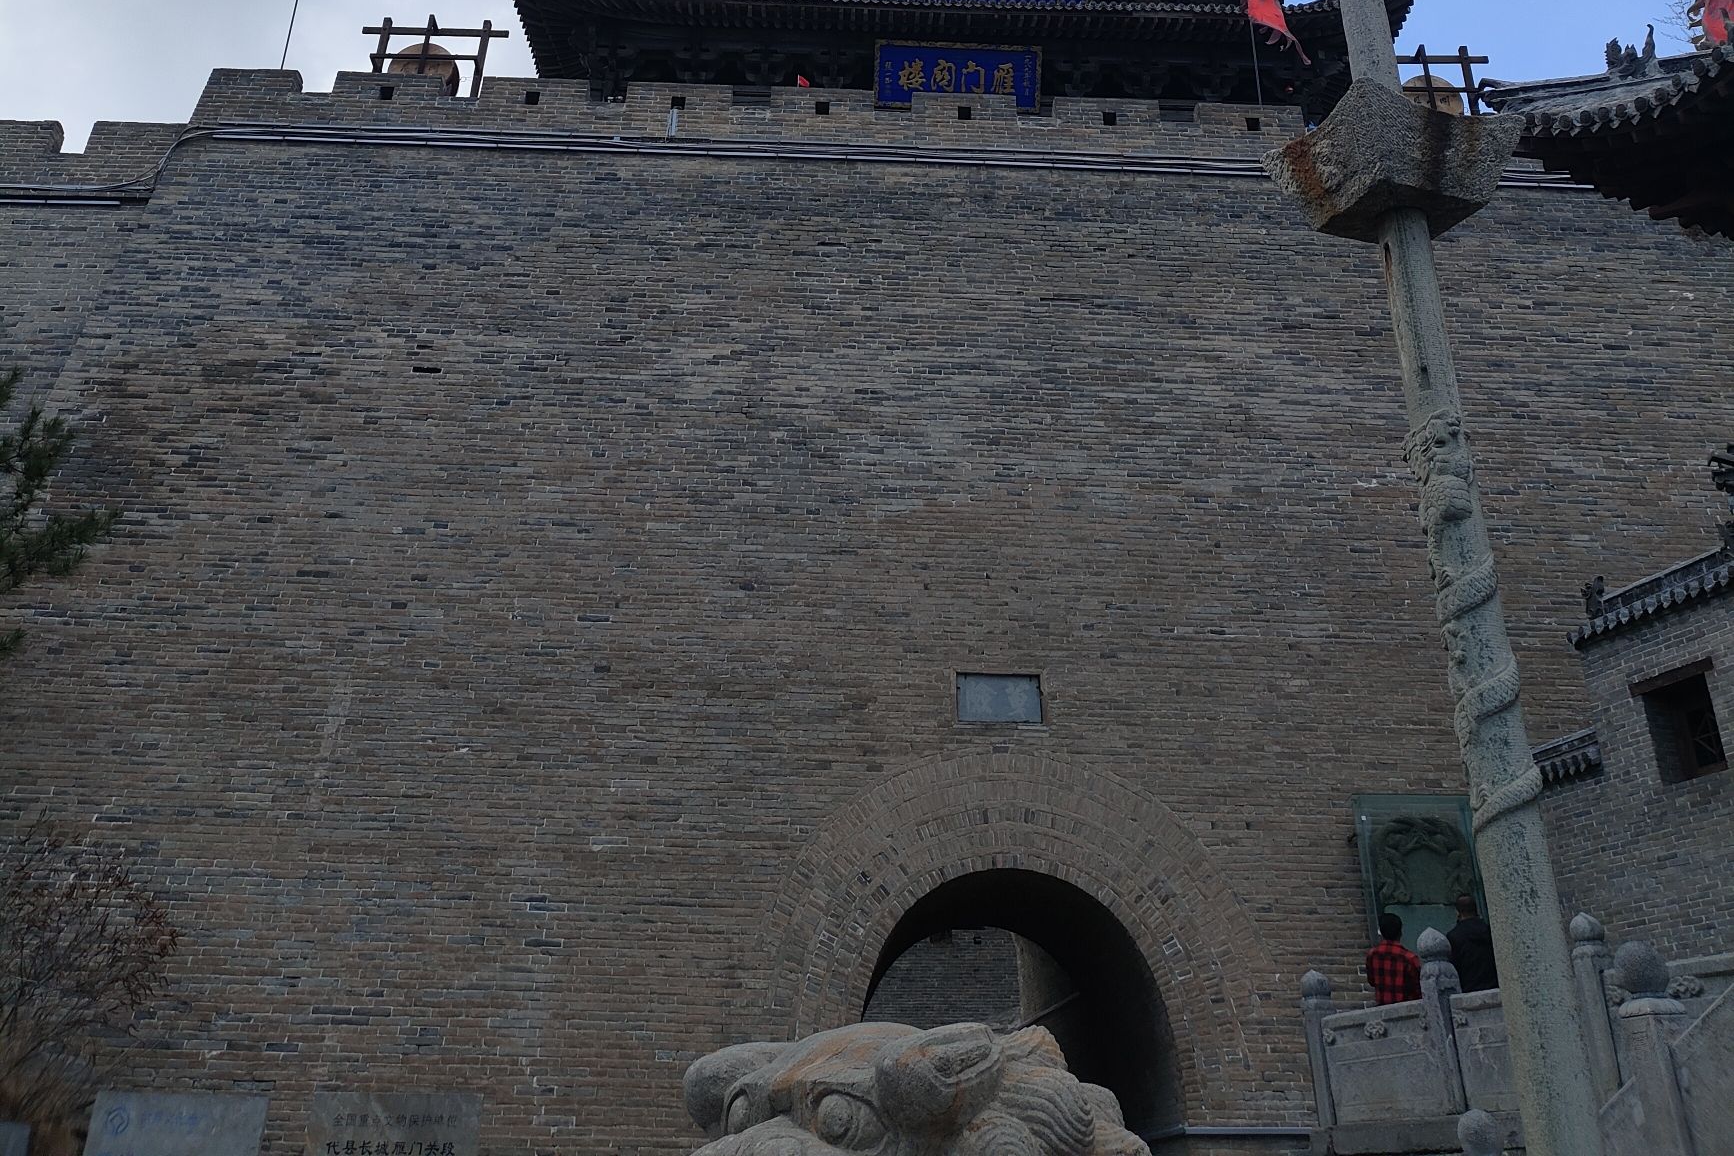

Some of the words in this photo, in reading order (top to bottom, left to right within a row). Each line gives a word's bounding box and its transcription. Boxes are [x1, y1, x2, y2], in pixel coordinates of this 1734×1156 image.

[332, 1112, 458, 1129] 全国重点文物保护单位
